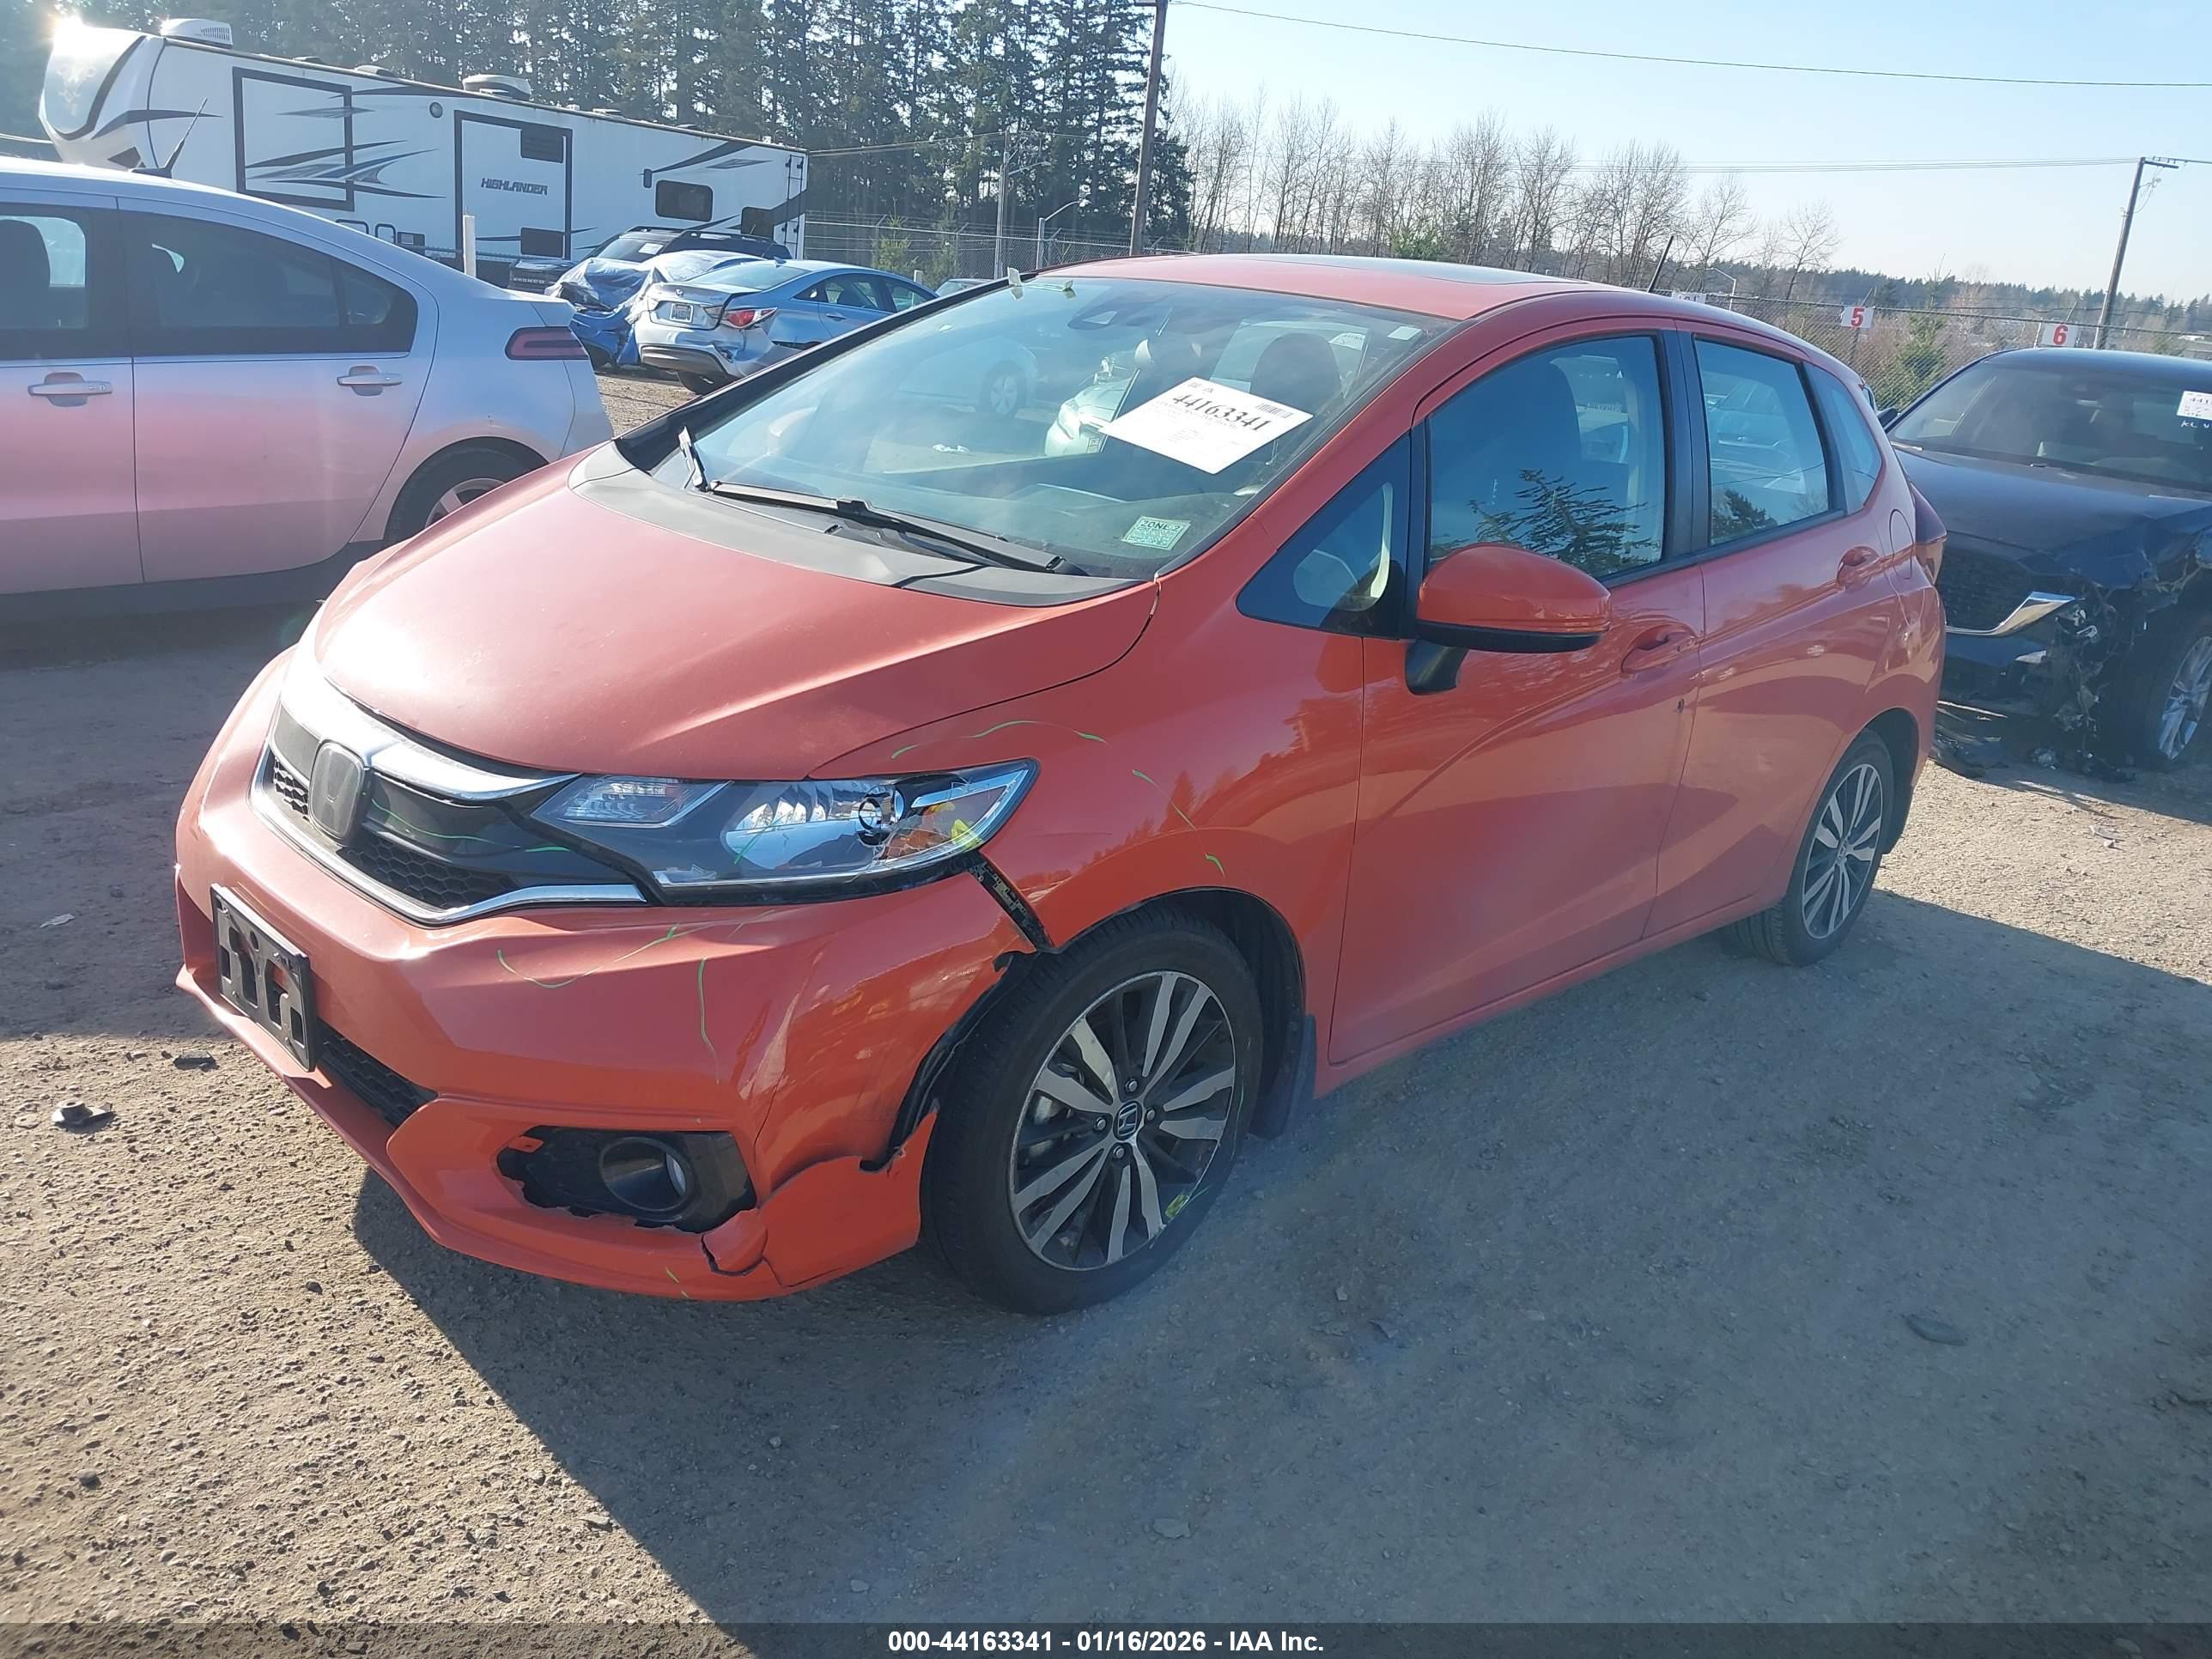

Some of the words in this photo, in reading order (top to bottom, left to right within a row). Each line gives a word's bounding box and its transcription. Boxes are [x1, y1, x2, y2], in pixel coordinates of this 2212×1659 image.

[481, 178, 548, 196] HIGHLANDER
[1850, 307, 1865, 327] 5
[2052, 325, 2069, 346] 6
[1172, 394, 1272, 431] 44163341
[1140, 520, 1170, 531] ZONE
